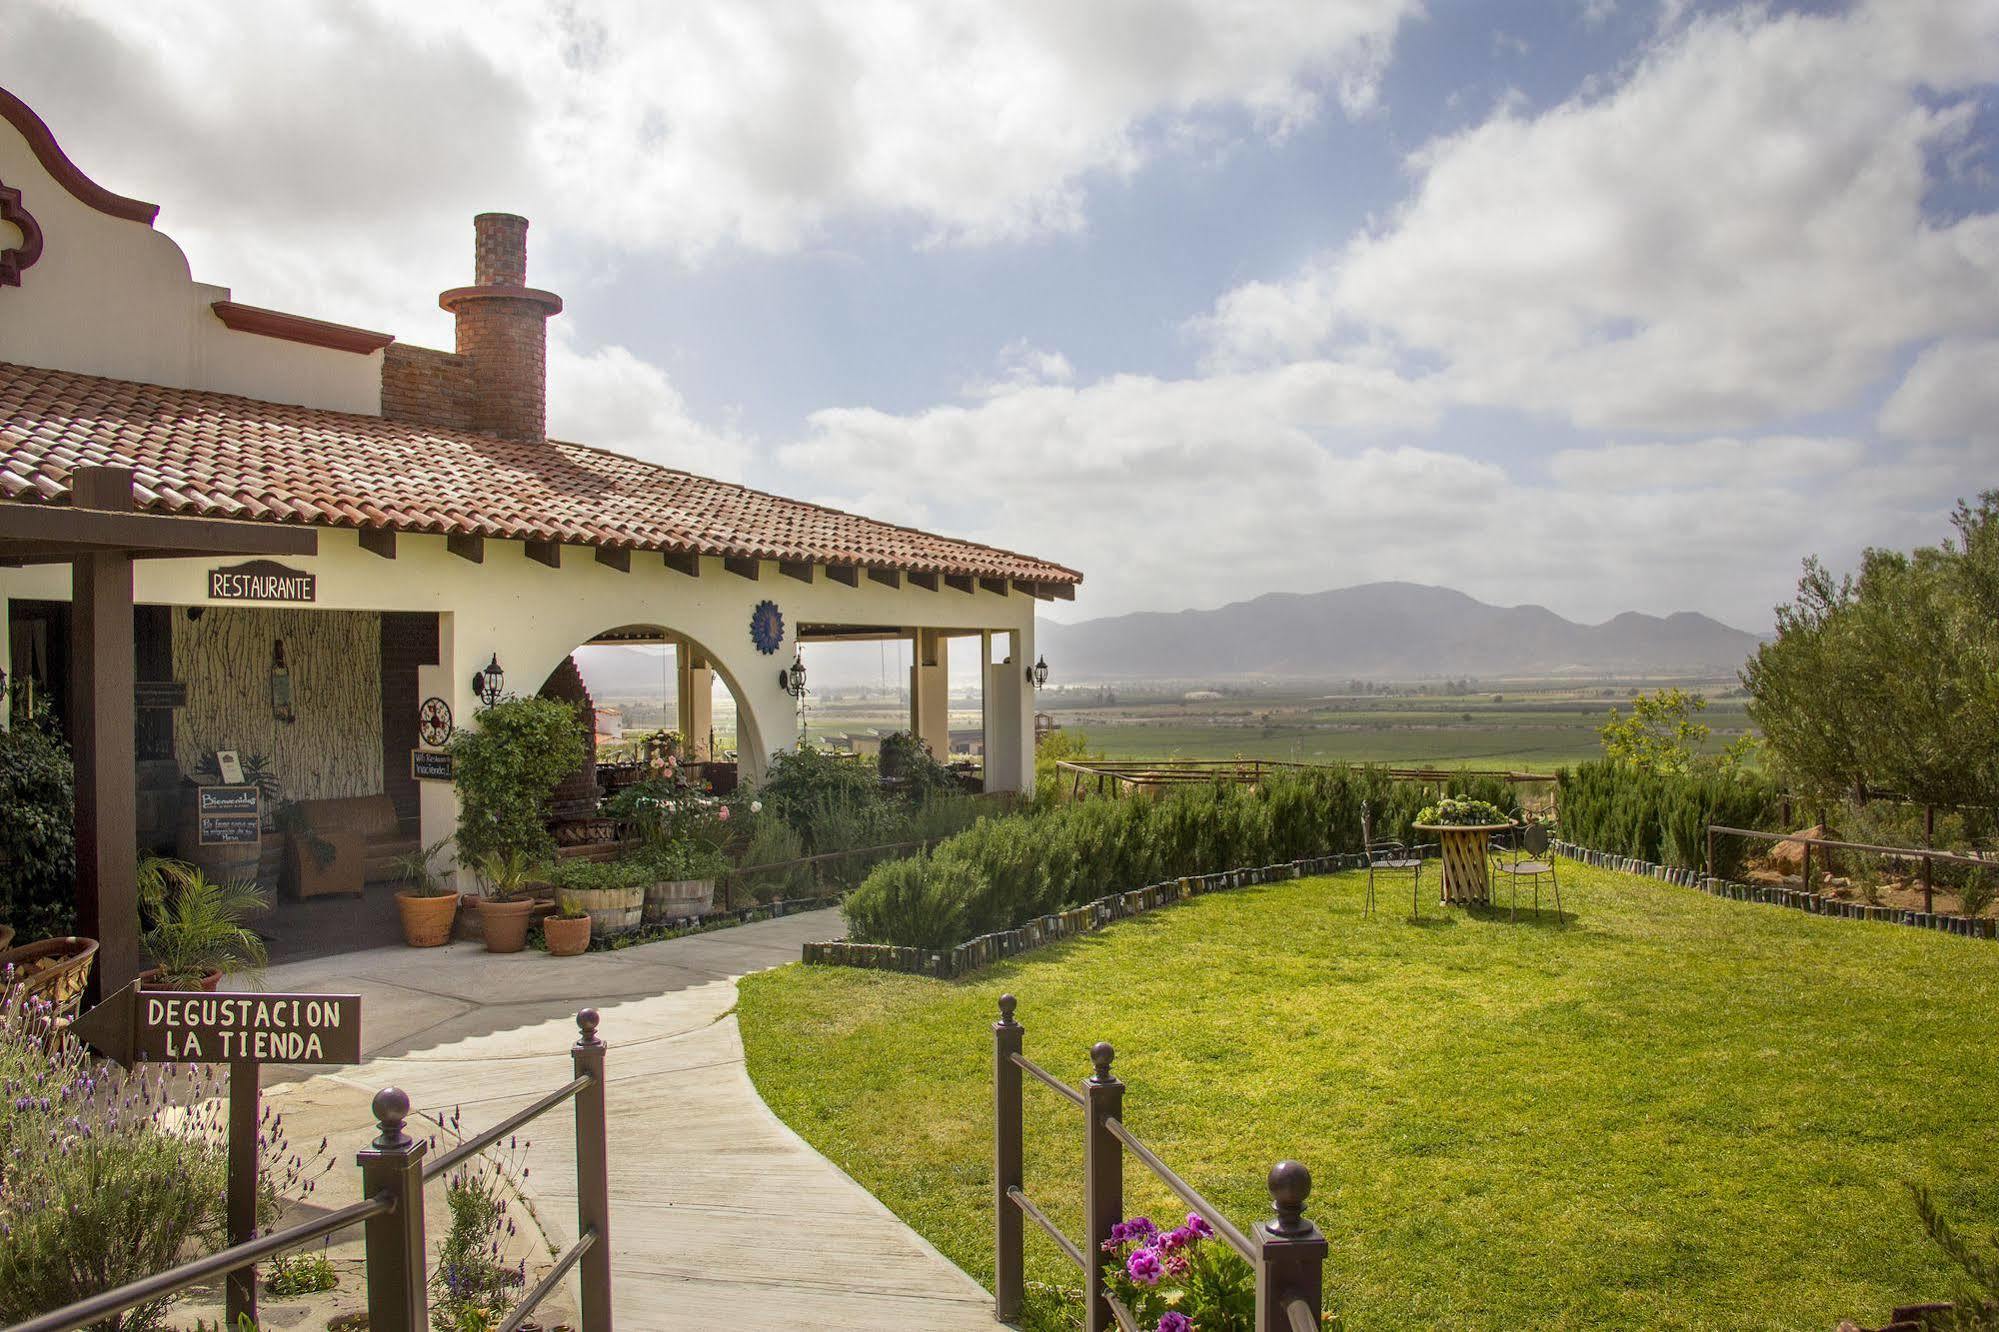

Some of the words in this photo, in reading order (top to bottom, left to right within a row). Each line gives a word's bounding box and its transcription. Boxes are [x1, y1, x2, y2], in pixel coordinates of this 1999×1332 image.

[213, 573, 311, 600] RESTAURANTE
[148, 999, 341, 1028] DEGUSTACION
[166, 1030, 202, 1057] LA
[218, 1031, 323, 1059] TIENDA
